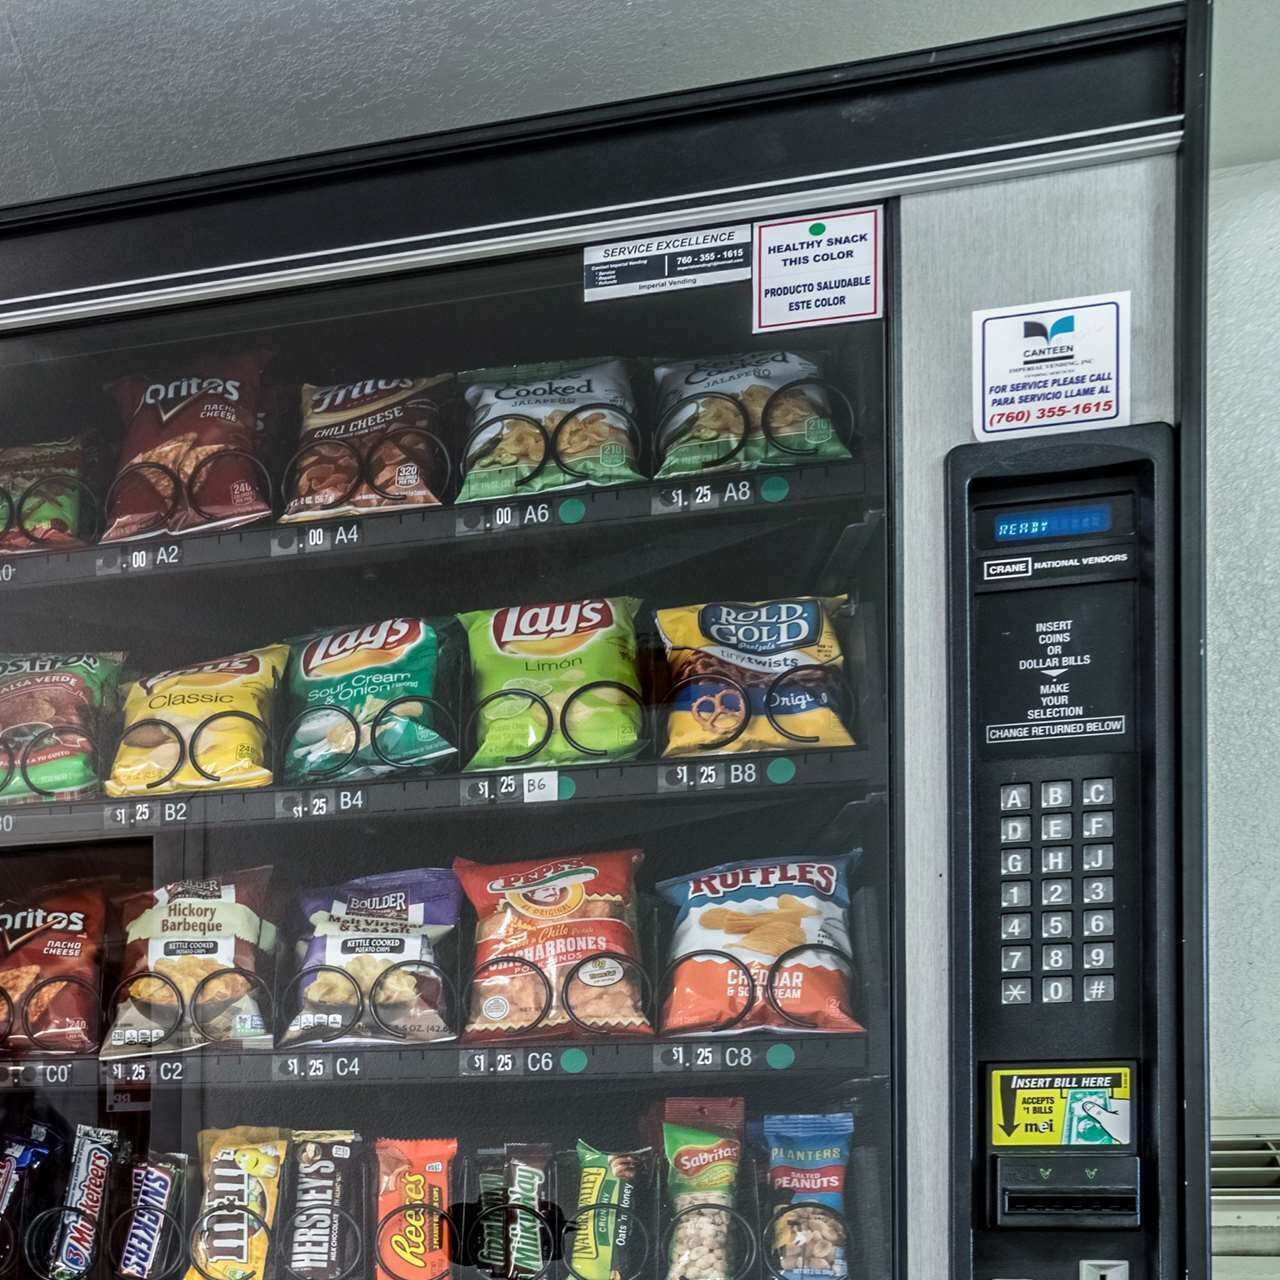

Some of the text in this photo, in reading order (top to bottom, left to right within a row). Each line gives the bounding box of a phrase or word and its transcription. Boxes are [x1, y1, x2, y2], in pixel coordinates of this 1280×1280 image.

[603, 232, 735, 258] SERVICE EXCELLENCE
[768, 233, 868, 254] HEALTHY SNACK
[781, 250, 853, 267] THIS COLOR
[764, 276, 871, 298] PRODUCTO SALUDABLE
[789, 296, 845, 311] ESTE COLOR
[1023, 345, 1073, 357] CANTEEN
[989, 372, 1112, 394] FOR SERVICE PLEASE CALL
[991, 398, 1015, 407] PARA
[1018, 391, 1061, 404] SERVICIO
[1065, 388, 1095, 398] LLAME
[989, 400, 1112, 427] (760) 355-1615
[724, 483, 749, 500] A8
[524, 506, 549, 522] A6
[1000, 521, 1048, 535] READY
[157, 546, 178, 563] A2
[989, 554, 1128, 574] CRANE NATIONAL VENDORS
[720, 602, 806, 623] ROLD
[499, 601, 604, 642] Lay's
[1036, 620, 1072, 632] INSERT
[709, 618, 809, 645] GOLD
[1039, 633, 1070, 644] COINS
[304, 619, 411, 667] Lay's
[1047, 645, 1061, 655] OR
[525, 654, 582, 672] Limón
[1019, 655, 1090, 669] DOLLAR BILLS
[1040, 683, 1070, 694] MAKE
[148, 691, 234, 709] Classic
[1041, 695, 1068, 706] YOUR
[1027, 707, 1083, 719] SELECTION
[990, 720, 1121, 739] CHANGE RETURNED BELOW
[731, 765, 756, 783] B8
[527, 779, 546, 791] B6
[341, 792, 362, 808] B4
[1007, 784, 1104, 807] A B C
[1009, 818, 1103, 840] D E F
[1008, 850, 1103, 872] G H J
[690, 862, 836, 899] RUFFLES
[168, 903, 217, 920] Hickory
[160, 918, 222, 935] Barbeque
[42, 947, 80, 957] CHEESE
[47, 940, 82, 951] NACHO
[528, 1053, 552, 1071] C6
[726, 1047, 752, 1065] C8
[336, 1059, 359, 1075] C4
[1011, 1075, 1111, 1090] INSERT BILL HERE
[1022, 1096, 1055, 1105] ACCEPTS
[1024, 1119, 1054, 1133] mei
[771, 1146, 840, 1161] PLANTERS
[775, 1176, 839, 1190] PEANUTS
[291, 1160, 336, 1269] HERSHEY'S
[121, 1170, 171, 1279] SNICKERS
